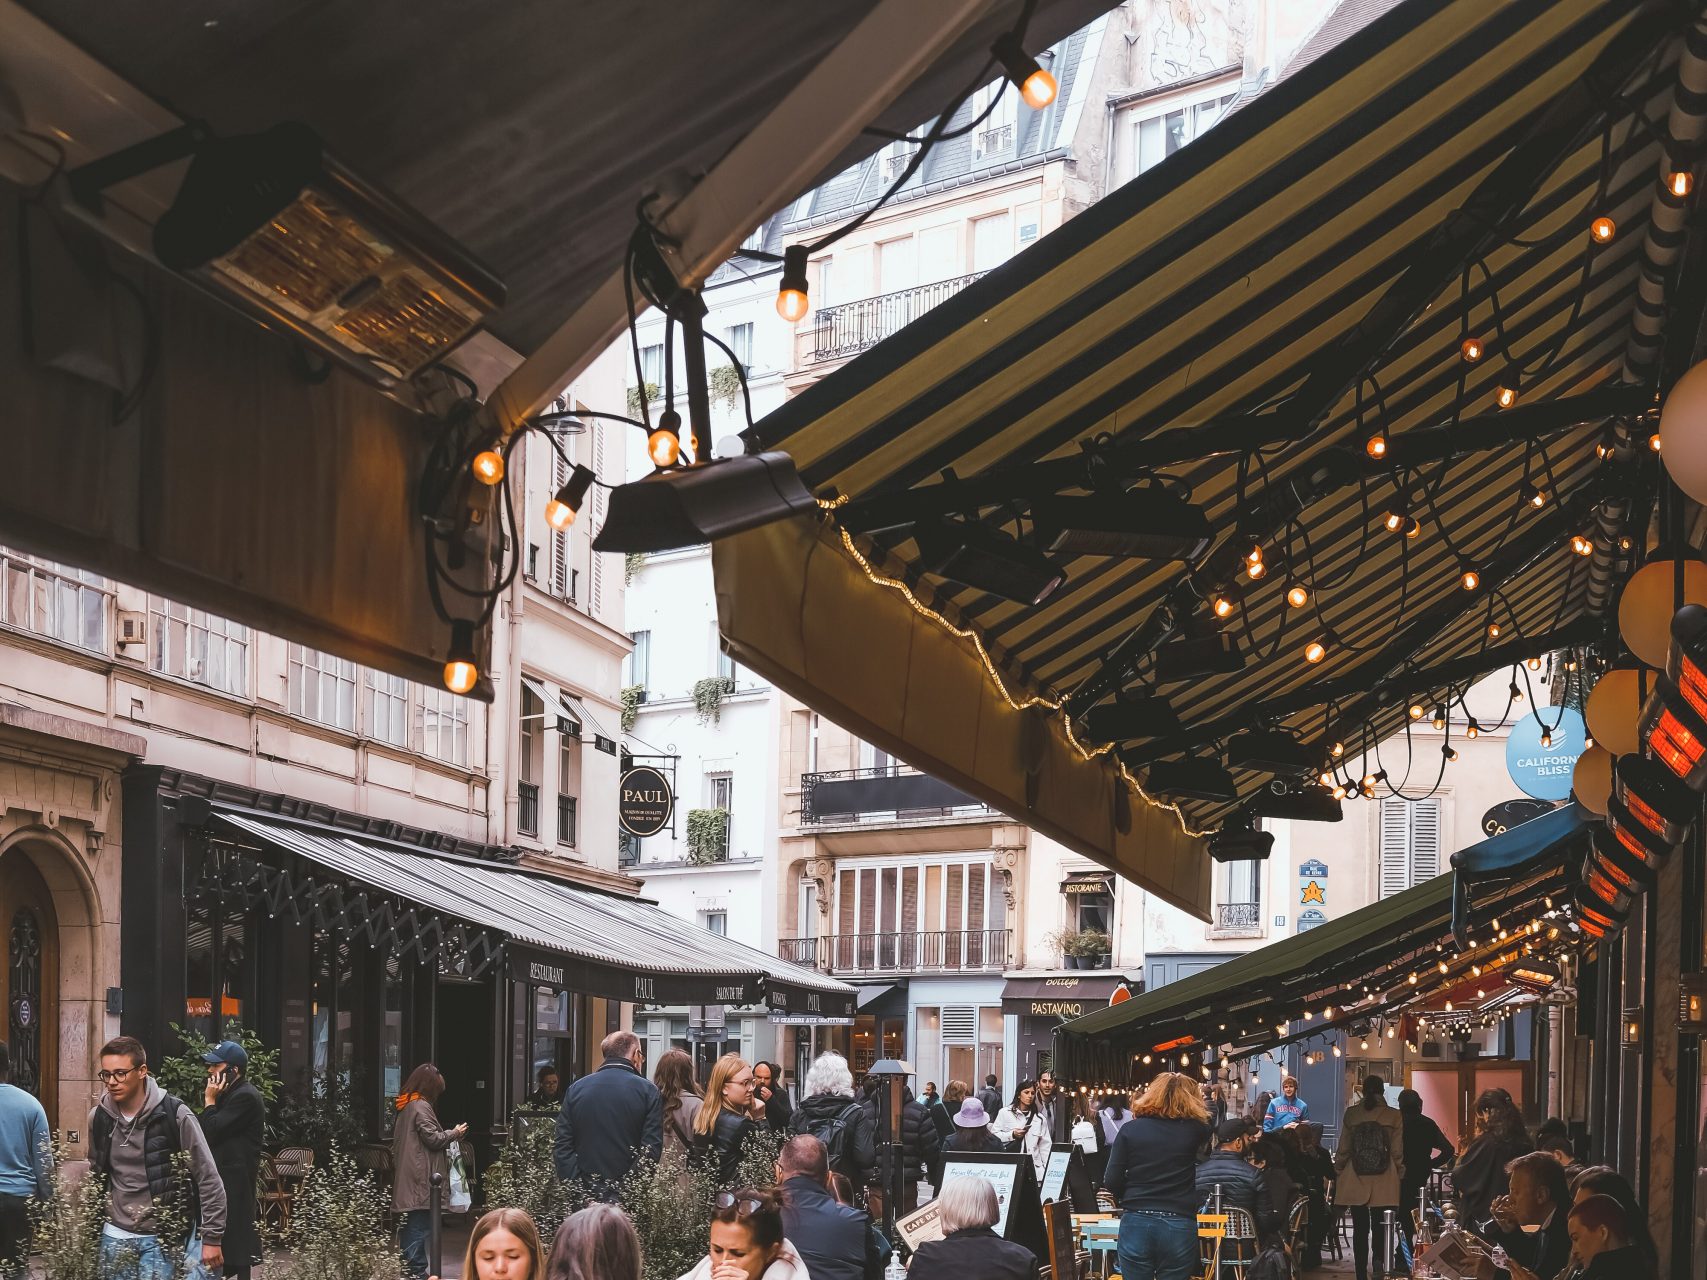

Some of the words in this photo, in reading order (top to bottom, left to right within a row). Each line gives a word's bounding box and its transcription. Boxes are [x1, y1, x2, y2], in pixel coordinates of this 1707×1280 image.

[1537, 766, 1570, 776] BLISS
[623, 789, 667, 803] PAUL
[1066, 883, 1102, 893] RISTORANTE
[1276, 916, 1284, 926] 18
[530, 962, 564, 984] RESTAURANT
[635, 976, 655, 1000] PAUL
[716, 986, 729, 1000] SALON
[729, 987, 736, 1000] DE
[736, 984, 744, 1000] THÉ
[807, 993, 821, 1012] PAUL
